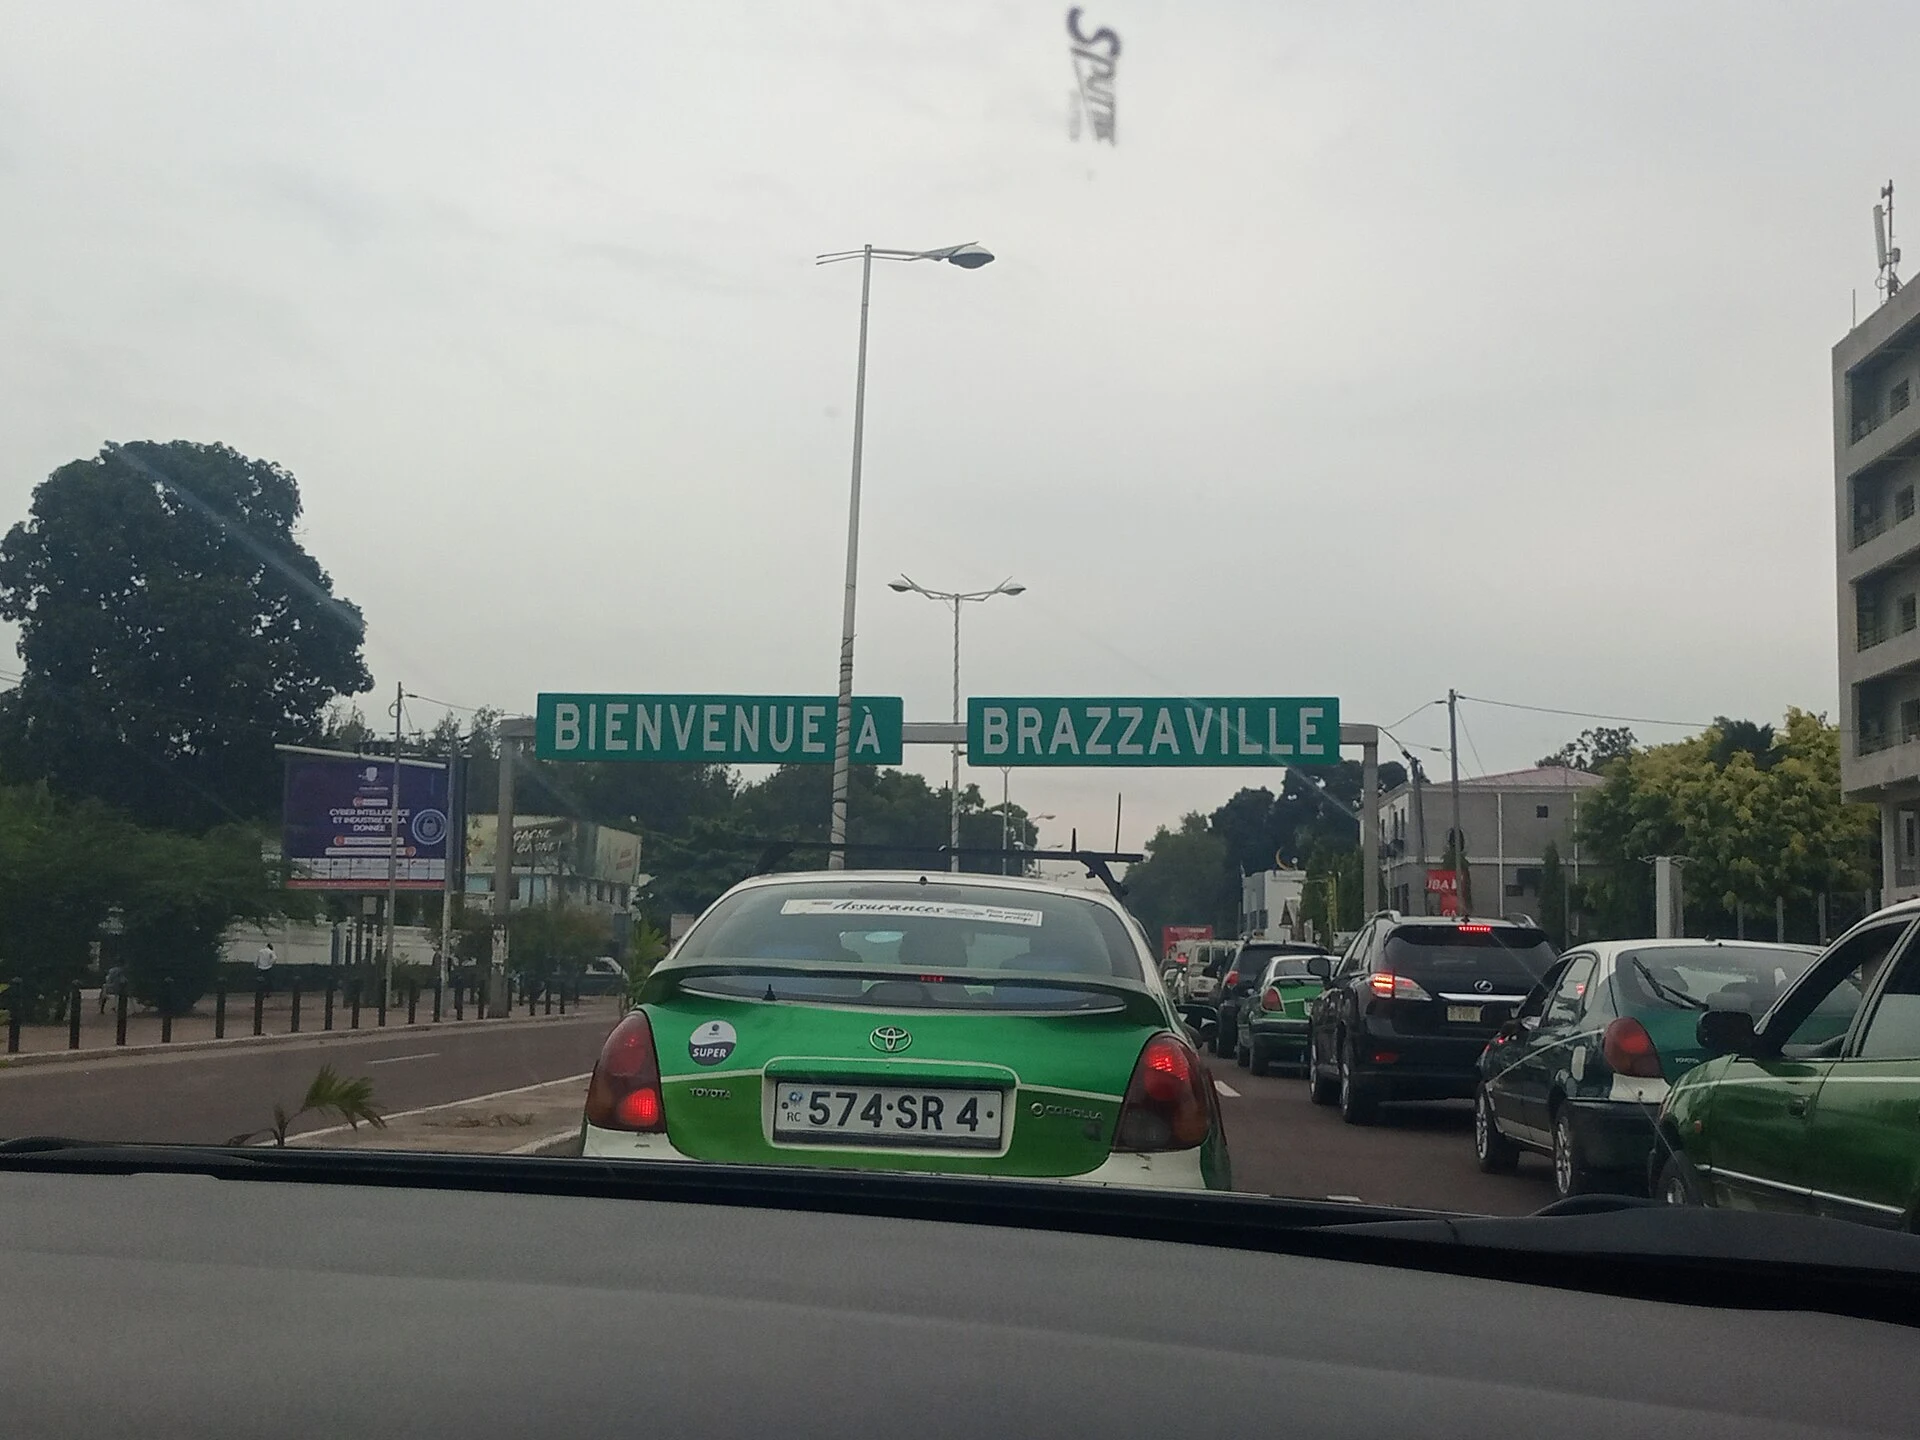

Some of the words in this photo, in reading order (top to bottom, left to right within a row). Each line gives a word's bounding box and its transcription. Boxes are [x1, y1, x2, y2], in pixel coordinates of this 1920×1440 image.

[554, 703, 826, 753] BIENVENUE
[855, 706, 881, 754] À
[983, 707, 1325, 755] BRAZZAVILLE
[833, 901, 944, 913] Assurances
[692, 1047, 727, 1058] SUPER
[690, 1087, 732, 1098] TOYOTA
[787, 1112, 800, 1122] RC
[809, 1091, 883, 1128] 574
[896, 1095, 944, 1130] SR
[956, 1097, 979, 1132] 4
[1046, 1105, 1104, 1120] COROLLA
